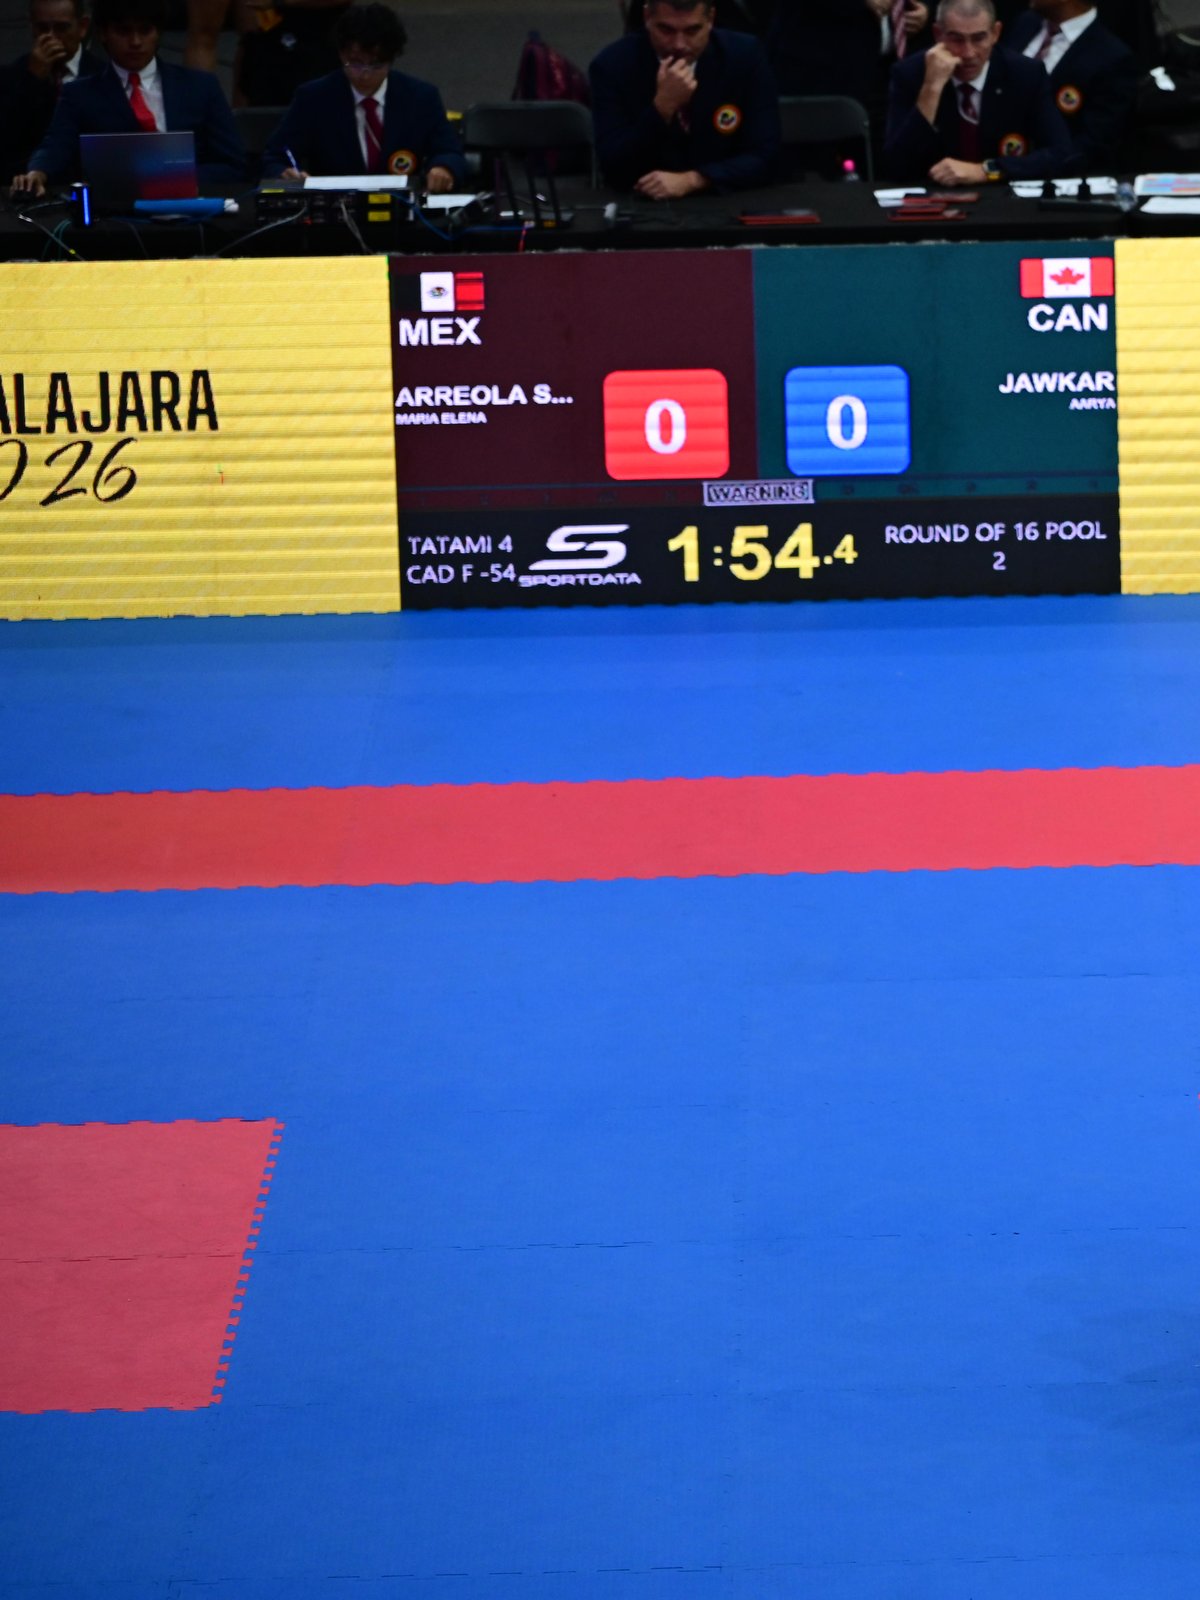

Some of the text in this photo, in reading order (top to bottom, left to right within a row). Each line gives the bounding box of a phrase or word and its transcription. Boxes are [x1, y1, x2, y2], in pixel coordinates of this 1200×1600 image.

[1027, 303, 1108, 332] CAN
[399, 317, 482, 346] MEX
[999, 370, 1115, 393] JAWKAR
[395, 384, 573, 407] ARREOLA S...
[395, 411, 487, 425] MARIA ELENA
[644, 399, 687, 455] 0
[826, 395, 868, 450] 0
[707, 483, 809, 502] WARNING
[885, 521, 1107, 543] ROUND OF 16 POOL
[408, 534, 513, 554] TATAMI 4
[992, 551, 1006, 571] 2
[406, 563, 516, 584] CAD F -54
[518, 572, 642, 588] SPORTDATA
